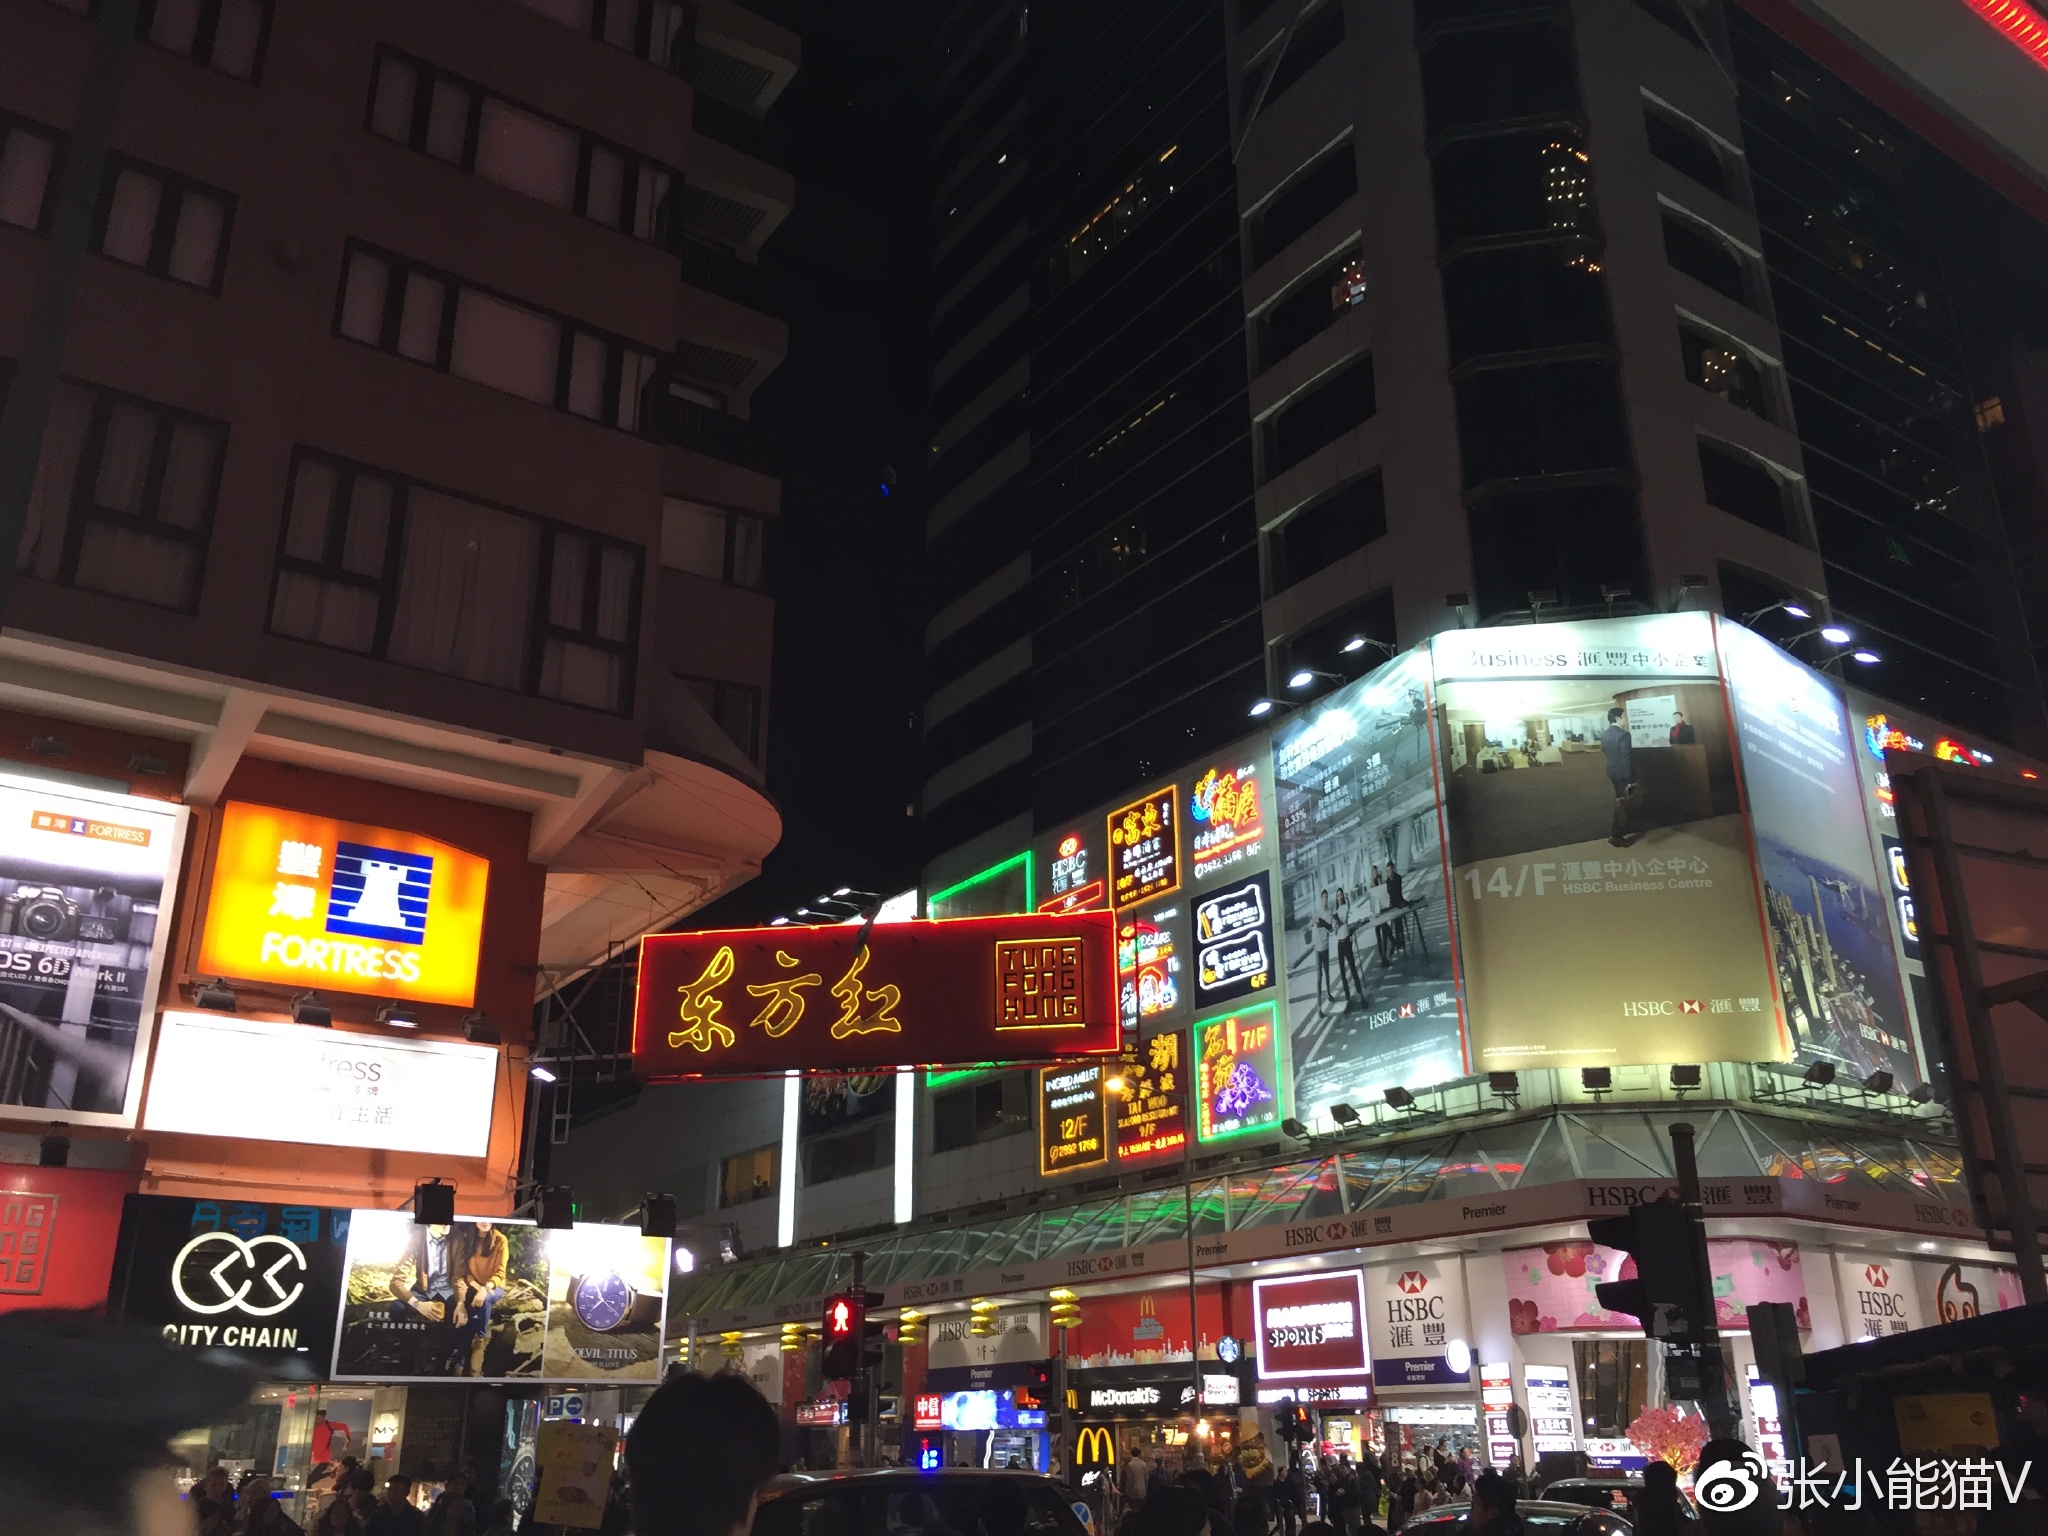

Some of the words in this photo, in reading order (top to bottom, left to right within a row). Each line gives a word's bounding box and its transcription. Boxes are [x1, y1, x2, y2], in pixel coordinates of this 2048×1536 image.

[1284, 808, 1307, 829] 0.33%
[90, 824, 145, 843] FORTRESS
[1052, 849, 1087, 880] HSBC
[1464, 863, 1557, 899] 14/F
[1561, 856, 1709, 881] 滙豐中小企中心
[1562, 882, 1602, 895] HSBC
[1605, 879, 1664, 893] Business
[1667, 877, 1713, 890] Centre
[37, 957, 71, 975] 6D
[261, 931, 421, 984] FORTRESS
[1003, 946, 1077, 970] TUNG
[1004, 969, 1076, 995] FONG
[1004, 994, 1078, 1020] HUNG
[1369, 1009, 1397, 1030] HSBC
[1416, 991, 1448, 1013] 滙豐
[1623, 1001, 1674, 1017] HSBC
[1710, 998, 1762, 1014] 滙豐
[1241, 1026, 1267, 1051] 7/F
[1859, 1023, 1880, 1043] HSBC
[1127, 1101, 1143, 1115] TAI
[1060, 1114, 1088, 1140] 12/F
[1586, 1186, 1656, 1206] HSBC
[1702, 1184, 1774, 1205] 滙豐
[1824, 1194, 1862, 1212] Premier
[1914, 1203, 1951, 1225] HSBC
[1285, 1225, 1324, 1247] HSBC
[1351, 1216, 1392, 1238] 滙豐
[1462, 1203, 1507, 1220] Premier
[1067, 1258, 1097, 1276] HSBC
[1115, 1251, 1144, 1270] 滙豐
[1196, 1242, 1228, 1257] Premier
[903, 1285, 926, 1300] HSBC
[1001, 1271, 1025, 1285] Premier
[1386, 1296, 1444, 1323] HSBC
[1857, 1290, 1906, 1317] HSBC
[162, 1324, 218, 1346] CITY
[223, 1326, 298, 1348] CHAIN
[938, 1320, 972, 1342] HSBC
[1268, 1327, 1325, 1347] SPORTS
[1389, 1323, 1448, 1348] 滙豐
[607, 1348, 638, 1360] TITUS
[970, 1368, 993, 1379] Premier
[1405, 1361, 1436, 1372] Premier
[1090, 1386, 1160, 1407] McDonald's
[1308, 1387, 1341, 1400] SPORTS
[917, 1396, 939, 1418] 中信
